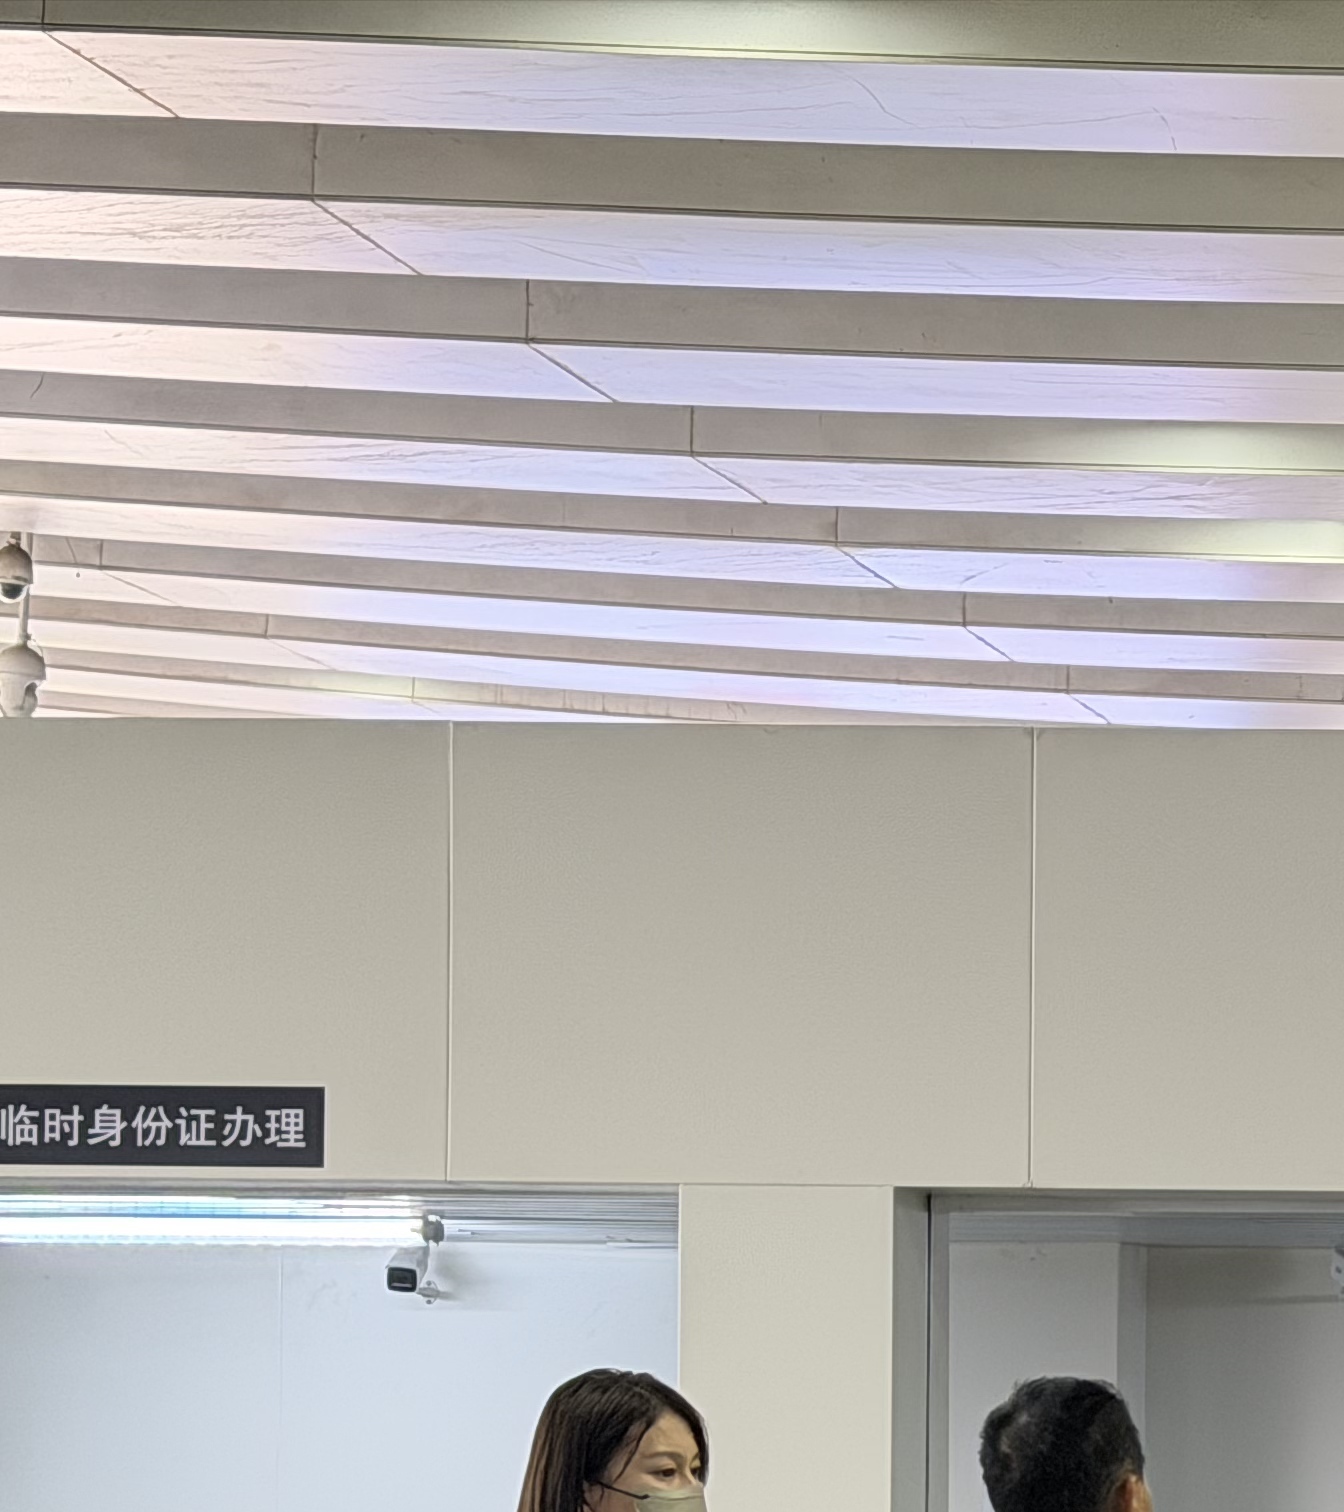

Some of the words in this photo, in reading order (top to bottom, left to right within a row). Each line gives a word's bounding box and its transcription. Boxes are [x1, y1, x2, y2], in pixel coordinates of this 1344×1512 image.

[0, 1103, 307, 1148] 临时身份证办理
